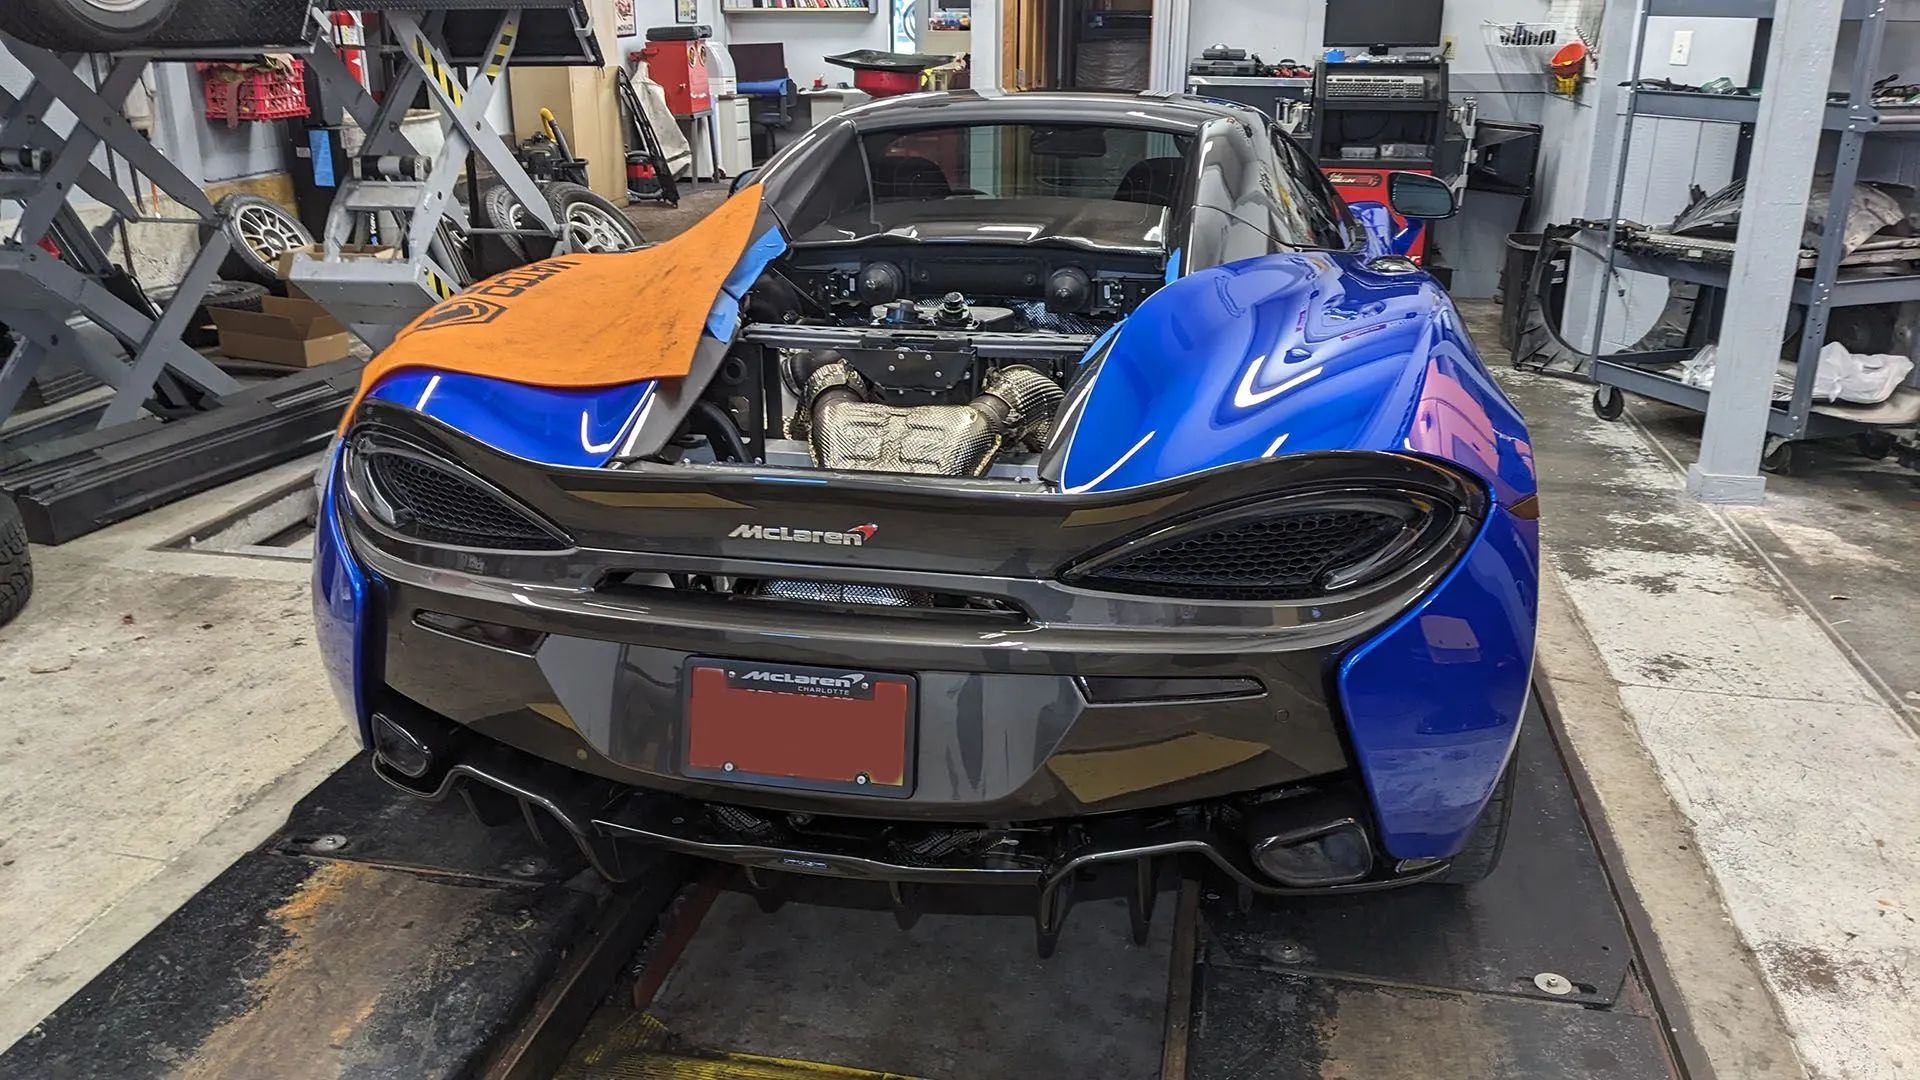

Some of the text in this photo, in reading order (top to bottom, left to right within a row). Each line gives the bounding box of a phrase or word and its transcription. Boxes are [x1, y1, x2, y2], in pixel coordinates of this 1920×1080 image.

[478, 260, 582, 298] MATCO
[728, 524, 863, 546] McLaren
[741, 671, 851, 688] McLaren
[797, 685, 850, 696] CHARLOTTE
